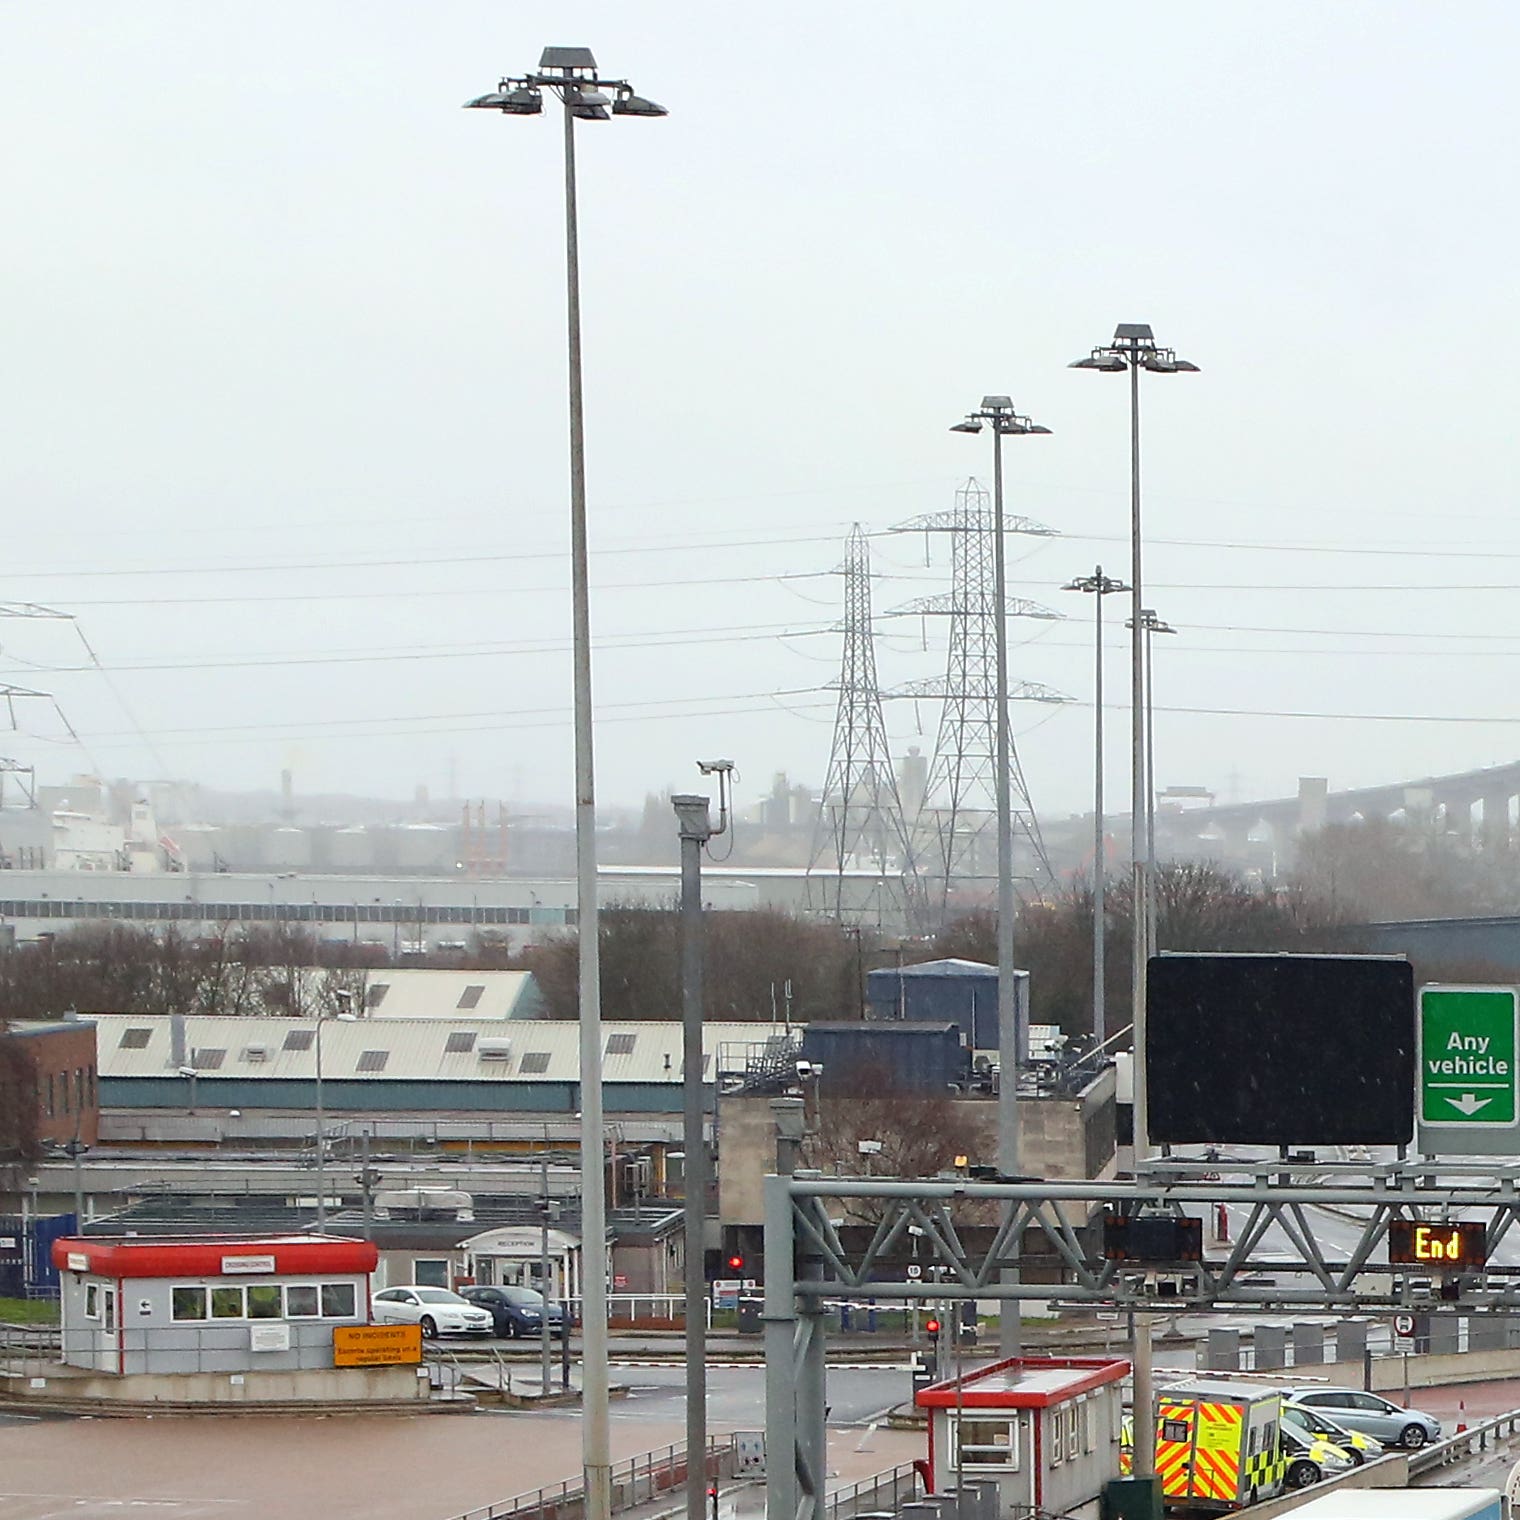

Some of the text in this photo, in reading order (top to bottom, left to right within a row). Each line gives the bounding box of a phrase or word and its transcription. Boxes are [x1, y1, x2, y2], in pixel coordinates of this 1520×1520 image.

[1447, 1032, 1490, 1053] Any
[1429, 1056, 1508, 1075] vehicle
[1415, 1227, 1460, 1259] End
[362, 1331, 406, 1340] INCIDENTS
